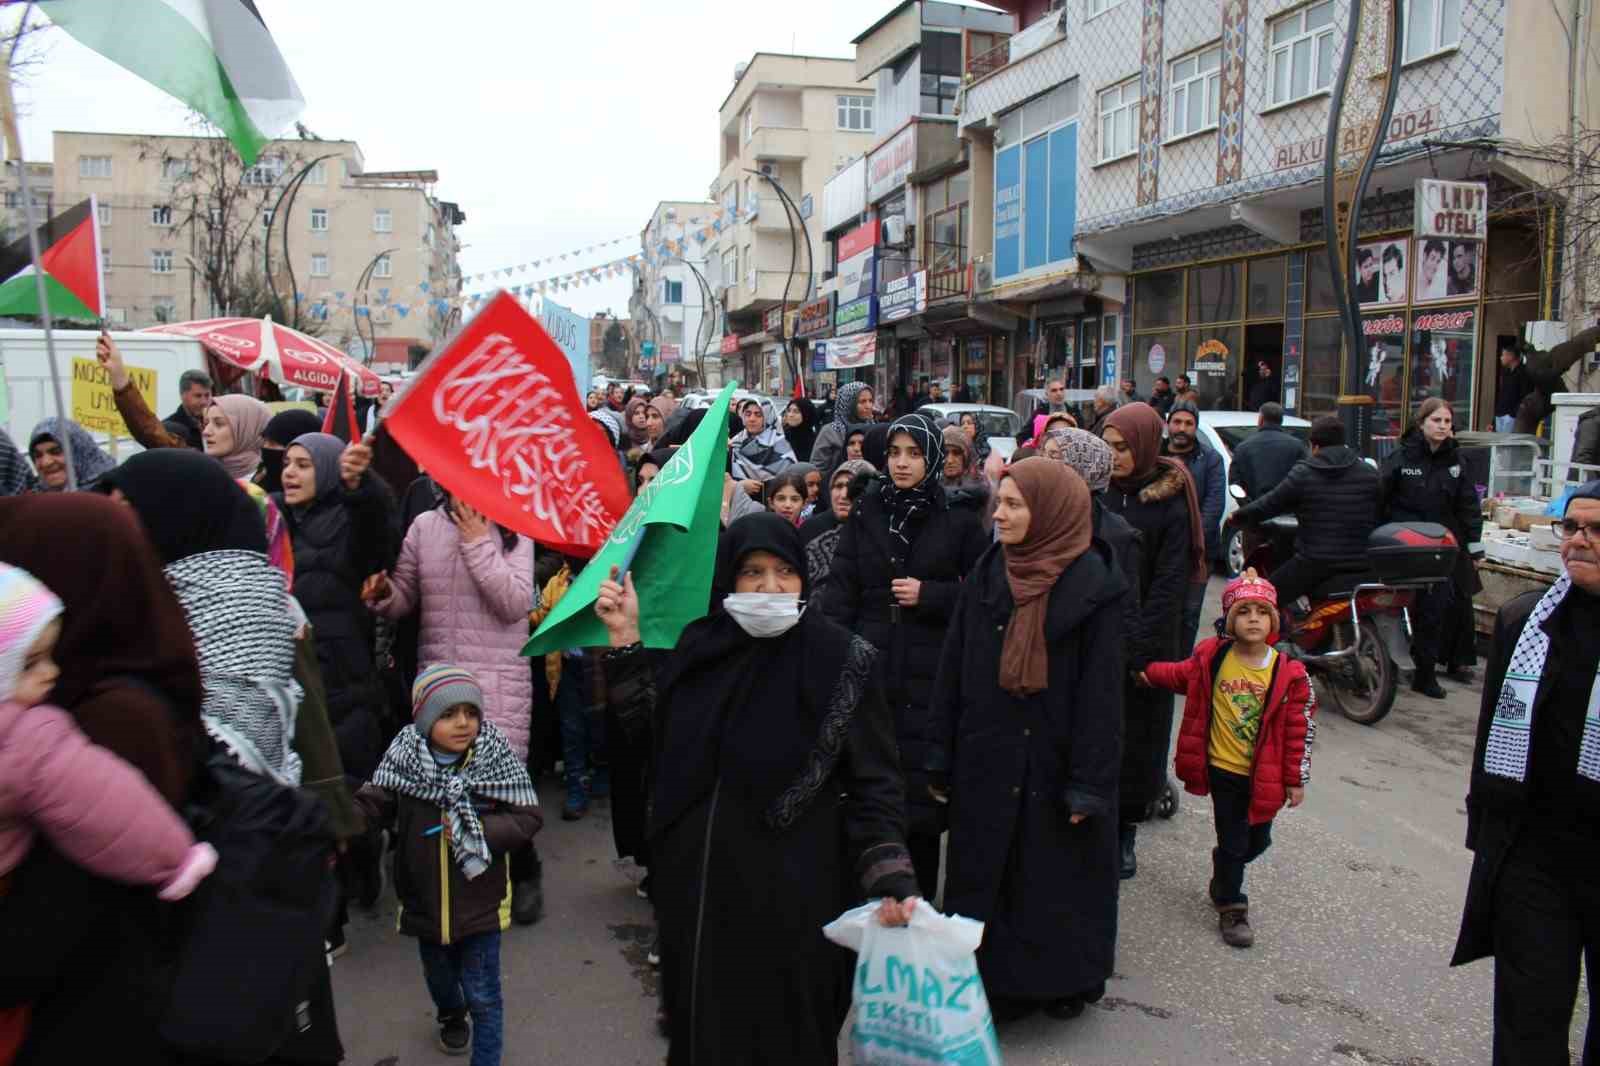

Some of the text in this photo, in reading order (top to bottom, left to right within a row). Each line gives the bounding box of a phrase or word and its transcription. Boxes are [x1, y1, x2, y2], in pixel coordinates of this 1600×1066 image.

[1276, 138, 1325, 168] ALKU
[1389, 109, 1434, 139] 004
[859, 955, 980, 1011] LMAZ
